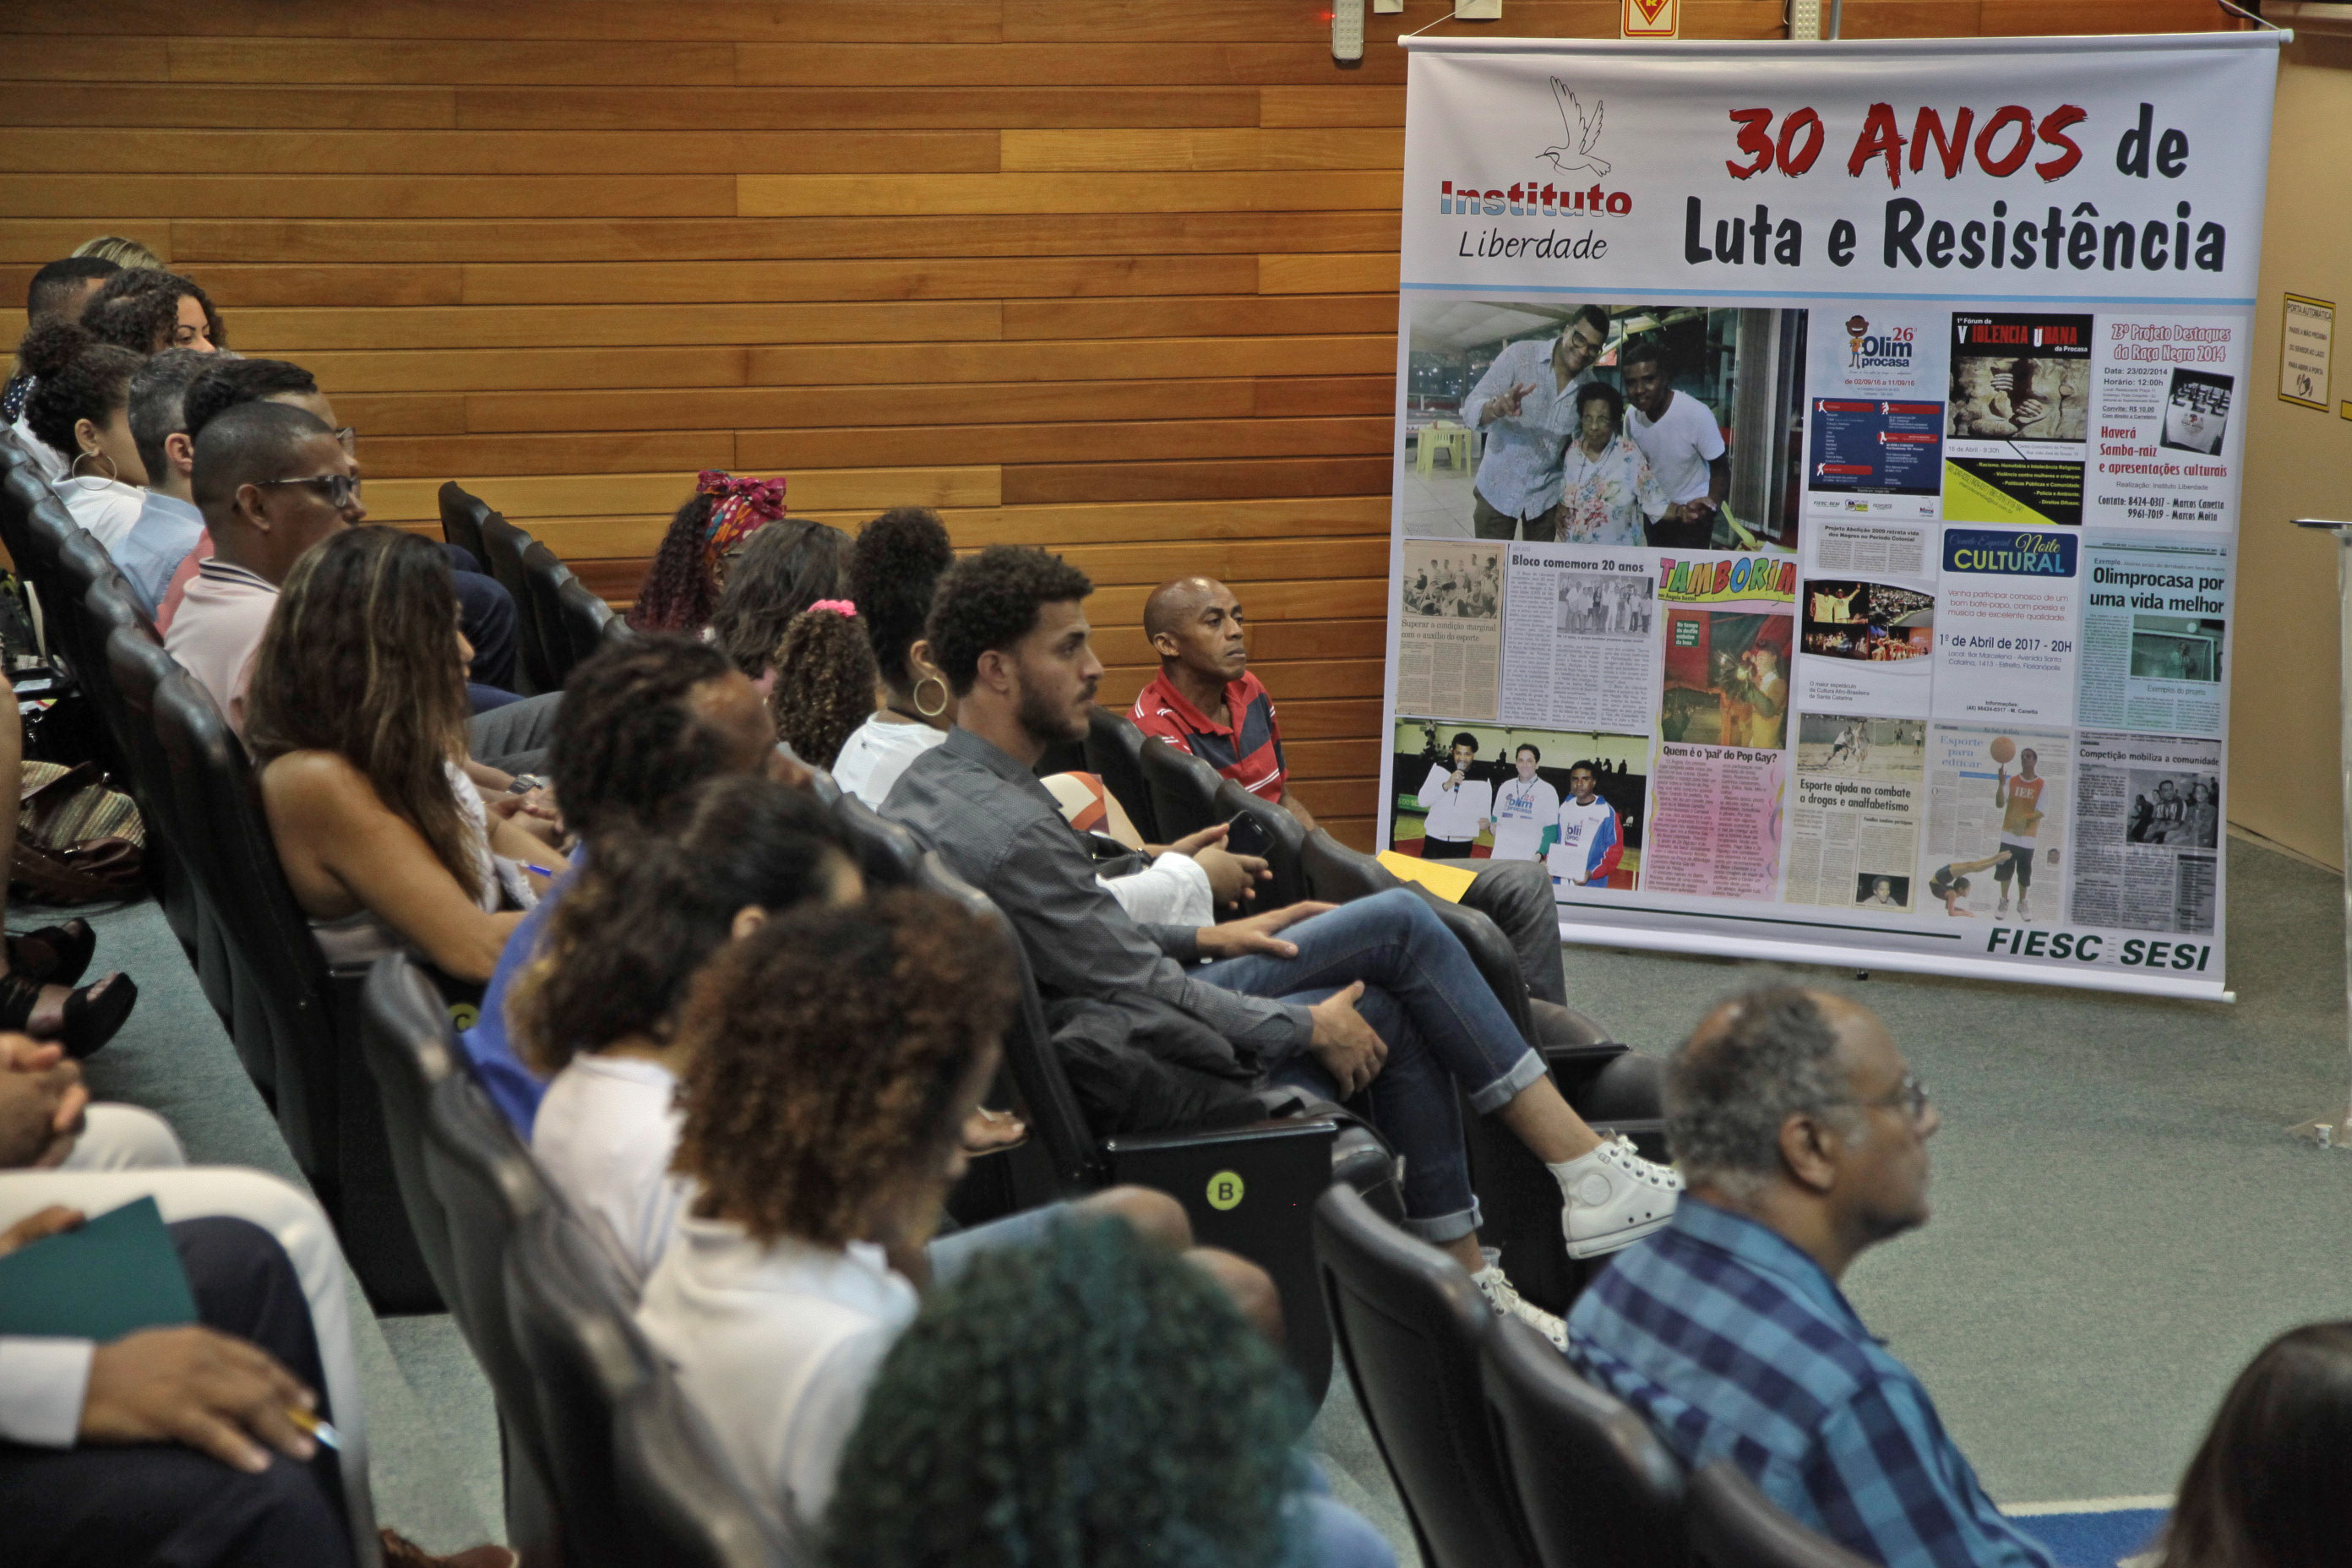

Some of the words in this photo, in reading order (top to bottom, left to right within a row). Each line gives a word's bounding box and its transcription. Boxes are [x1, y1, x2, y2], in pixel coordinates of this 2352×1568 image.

[1726, 106, 1825, 180] 30
[1848, 103, 2088, 190] ANOS
[2115, 103, 2189, 178] de
[1440, 180, 1633, 217] Instituto
[1685, 195, 1802, 266] Luta
[1828, 218, 1857, 266] e
[1884, 197, 2226, 273] Resistência
[1459, 229, 1609, 260] Liberdade
[2287, 303, 2301, 313] PORTA
[2302, 306, 2332, 320] AUTOMÁTICA
[2111, 324, 2129, 340] 23º
[2131, 324, 2172, 342] Projeto
[2174, 325, 2231, 343] Destaques
[1862, 335, 1913, 357] Olim
[2114, 344, 2129, 360] da
[2132, 344, 2159, 362] Raça
[2162, 345, 2195, 362] Negra
[2197, 346, 2226, 362] 2014
[1861, 357, 1909, 368] procasa
[2104, 378, 2136, 386] Horário:
[2101, 426, 2137, 439] Haverá
[2100, 443, 2158, 457] Samba-raiz
[2099, 462, 2104, 473] e
[2109, 463, 2180, 476] apresentações
[2184, 464, 2227, 477] culturais
[2099, 495, 2126, 506] Contato:
[2128, 496, 2164, 507] 8424-0317
[2173, 498, 2197, 509] Marcos
[2198, 499, 2224, 509] Canetta
[2127, 509, 2164, 519] 9961-7019
[2172, 510, 2196, 520] Marcos
[2015, 533, 2061, 555] Noite
[1512, 554, 1540, 567] Bloco
[1544, 558, 1598, 570] comemora
[1601, 559, 1615, 571] 20
[1618, 563, 1644, 573] anos
[1954, 549, 2065, 574] CULTURAL
[1659, 558, 1797, 596] TAMBORIM
[2093, 567, 2194, 589] Olimprocasa
[2199, 577, 2224, 592] por
[1974, 590, 2007, 599] participar
[2090, 593, 2126, 607] uma
[2131, 592, 2164, 610] vida
[2169, 596, 2224, 613] melhor
[1989, 611, 2025, 619] excelente
[2033, 603, 2058, 612] poesia
[1402, 619, 1429, 629] Superar
[1437, 622, 1465, 631] condição
[1467, 623, 1496, 633] marginal
[1952, 635, 1967, 647] de
[1969, 635, 1995, 648] Abril
[1997, 637, 2012, 650] de
[2015, 638, 2041, 651] 2017
[2051, 640, 2072, 653] 20H
[1940, 735, 1984, 747] Esporte
[1663, 745, 1688, 756] Quem
[1690, 748, 1695, 757] é
[1723, 749, 1734, 760] do
[1737, 750, 1753, 763] Pop
[1755, 752, 1778, 765] Gay?
[1948, 749, 1974, 758] para
[2079, 749, 2126, 761] Competição
[2129, 752, 2163, 763] mobiliza
[2172, 756, 2219, 766] comunidade
[1941, 758, 1982, 769] educar
[1800, 778, 1832, 793] Esporte
[1835, 782, 1858, 795] ajuda
[1861, 787, 1871, 795] no
[1875, 786, 1911, 798] combate
[2014, 787, 2035, 799] IEE
[1808, 793, 1838, 808] drogas
[1848, 798, 1909, 812] analfabetismo
[1986, 928, 2103, 962] FIESC
[2120, 939, 2212, 972] SESI
[1218, 1182, 1233, 1200] B
